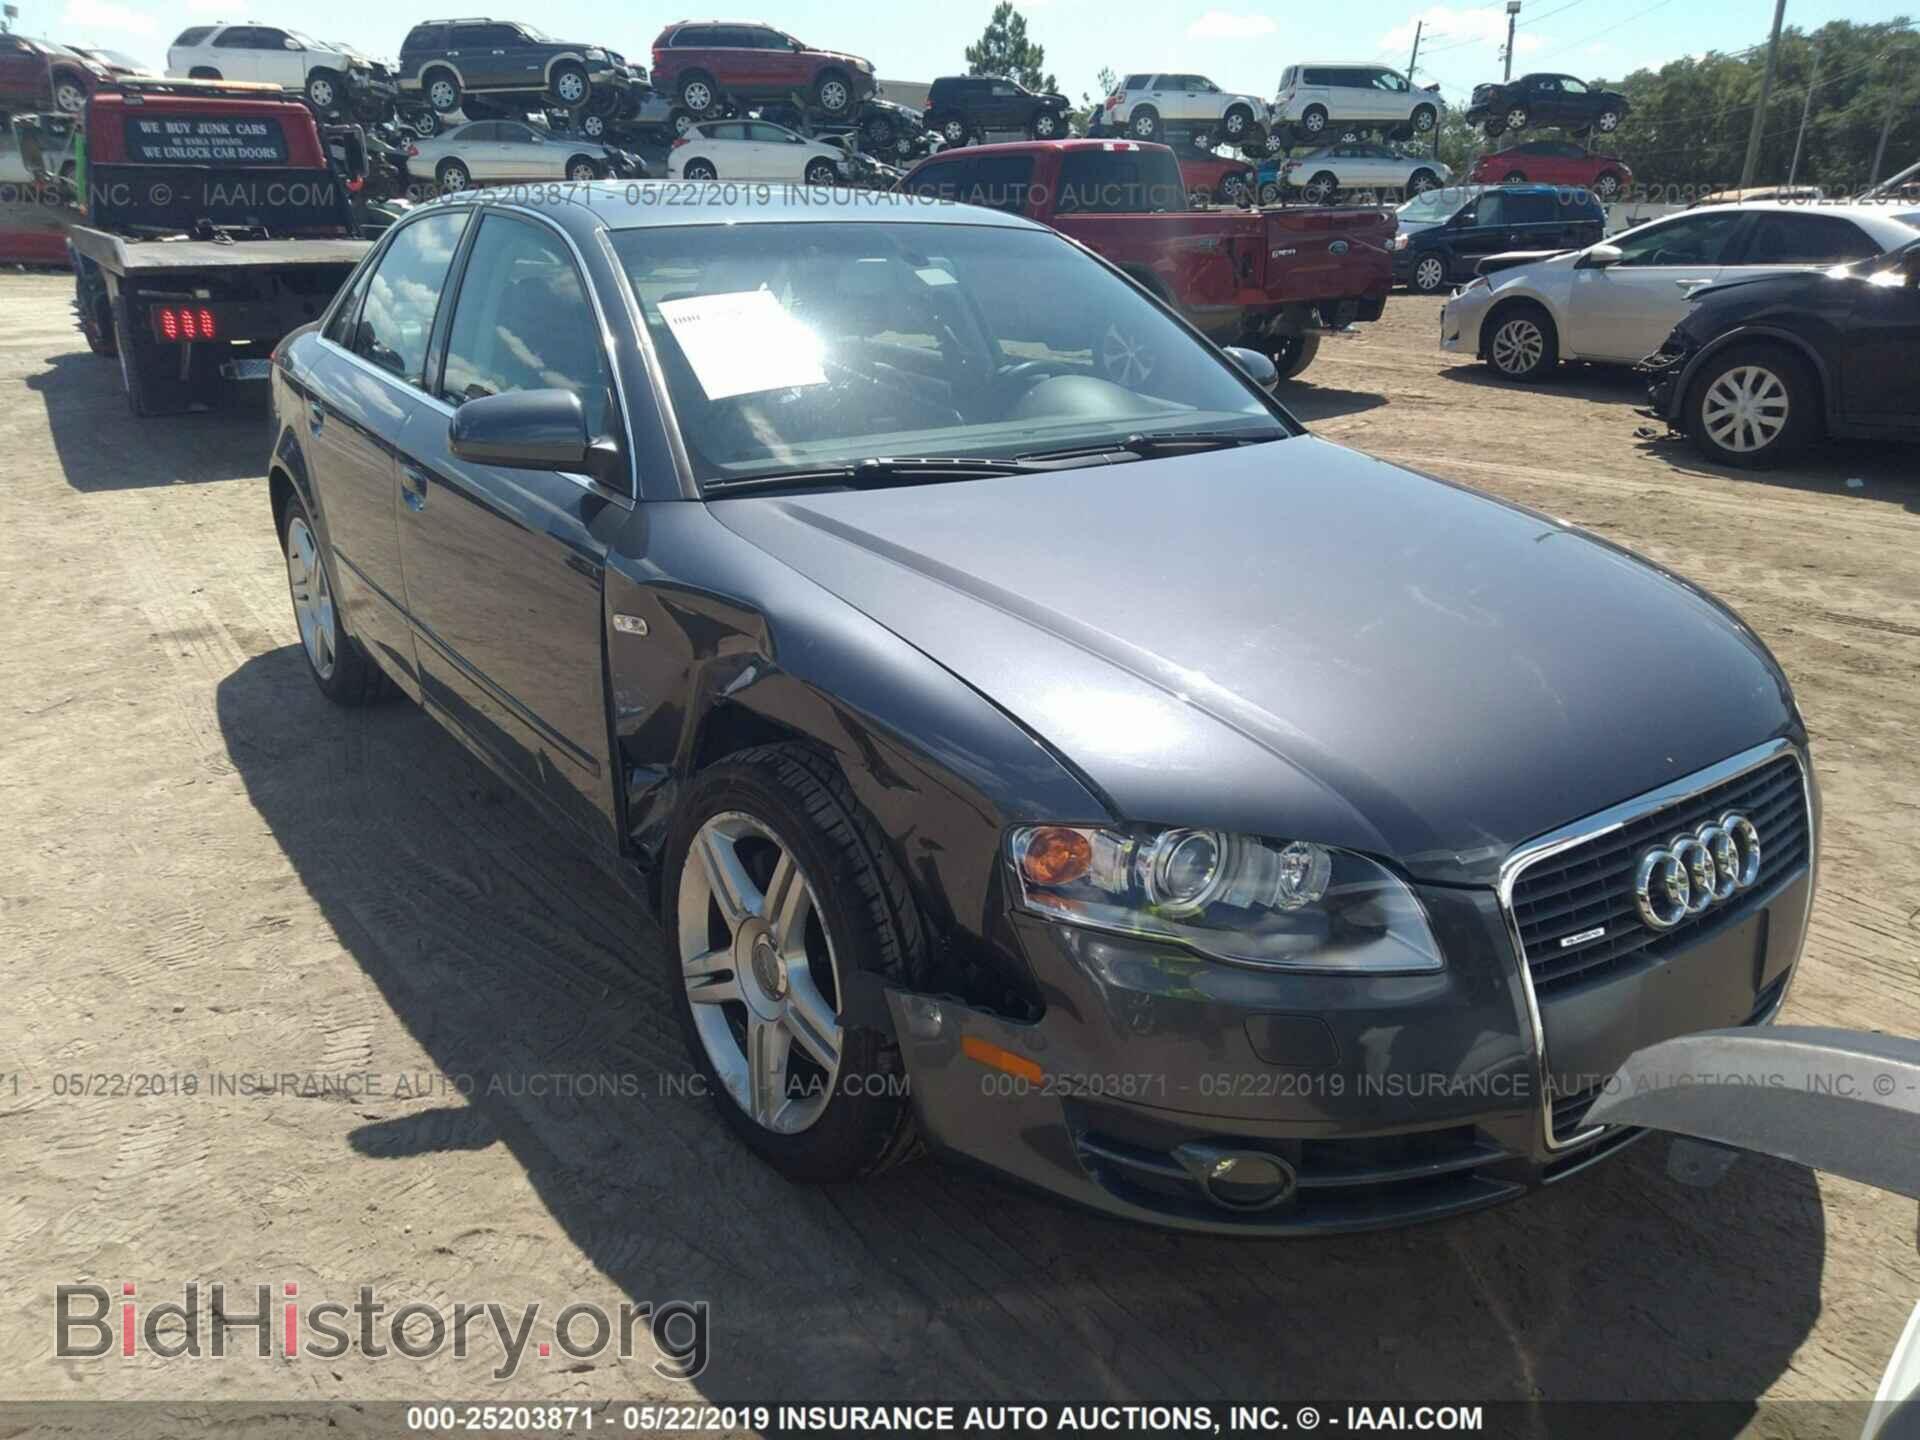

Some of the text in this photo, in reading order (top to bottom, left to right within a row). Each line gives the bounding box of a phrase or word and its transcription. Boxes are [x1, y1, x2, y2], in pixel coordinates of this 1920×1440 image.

[140, 121, 267, 136] WE BUY JUNK CARS
[143, 146, 278, 159] WE UNLOCK CAR DOORS
